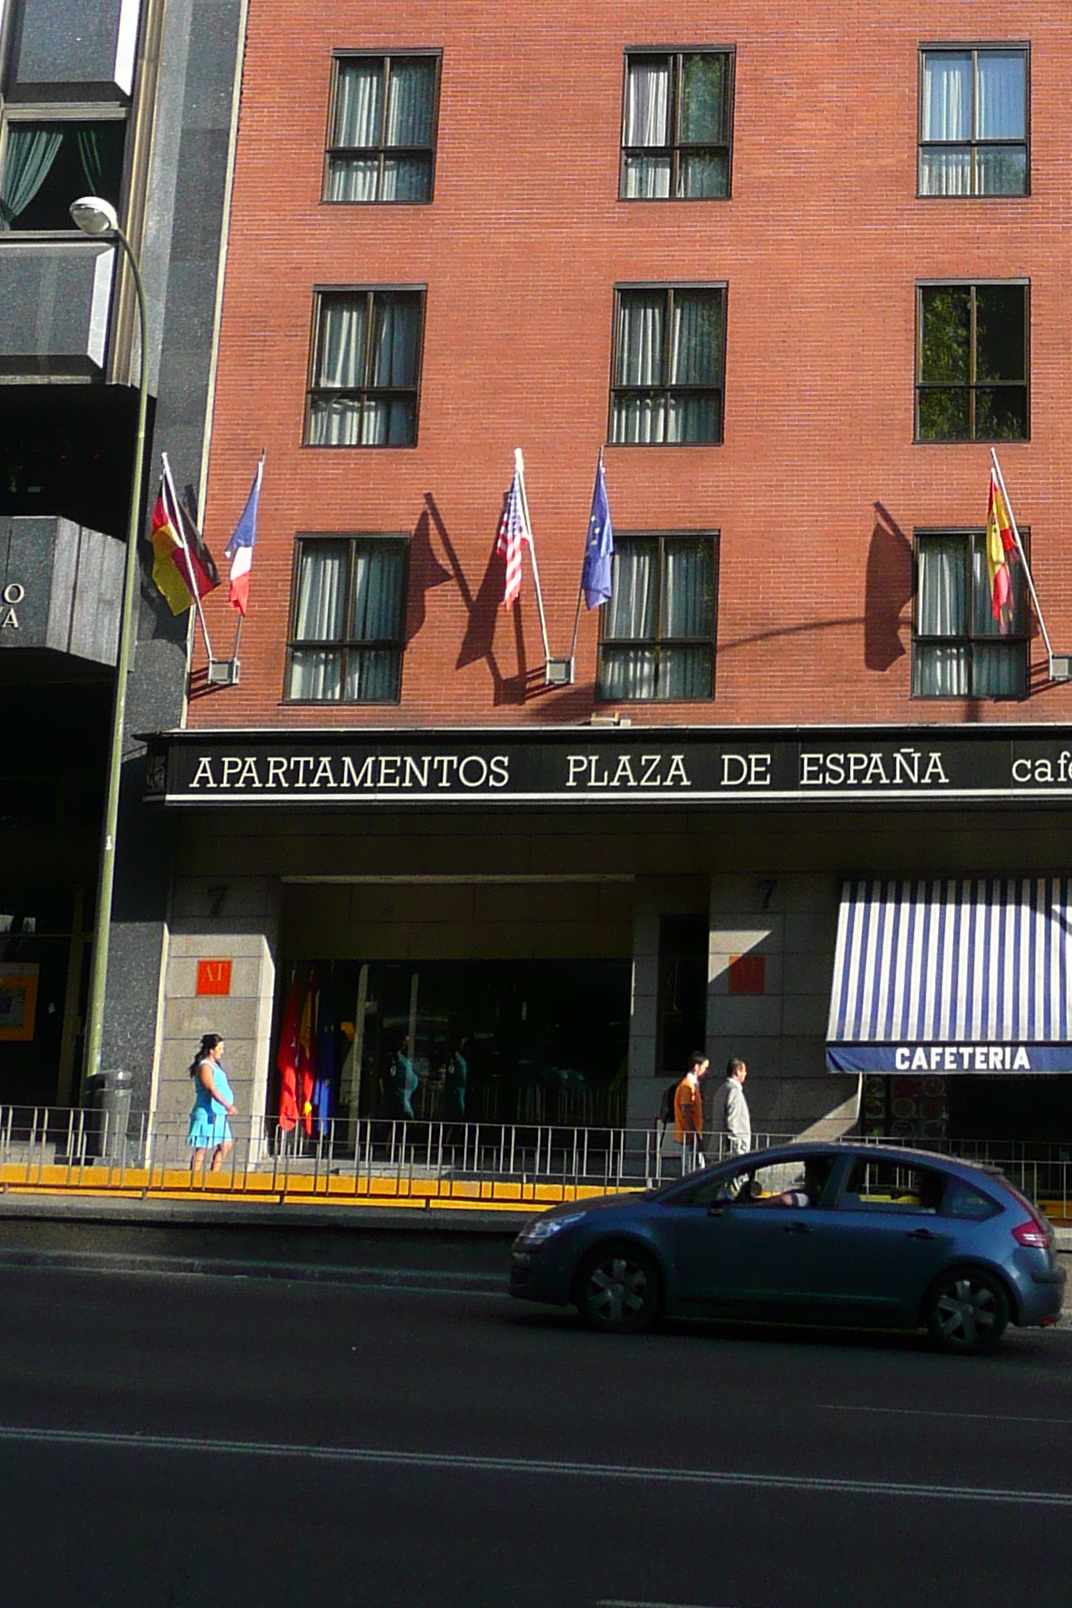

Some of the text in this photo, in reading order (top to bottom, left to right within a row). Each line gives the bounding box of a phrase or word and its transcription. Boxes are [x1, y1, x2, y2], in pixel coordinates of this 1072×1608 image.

[188, 754, 510, 789] APARTAMENTOS
[566, 754, 691, 787] PLAZA
[720, 753, 772, 786] DE
[800, 747, 950, 785] ESPAÑA
[894, 1045, 1031, 1071] CAFETERIA
